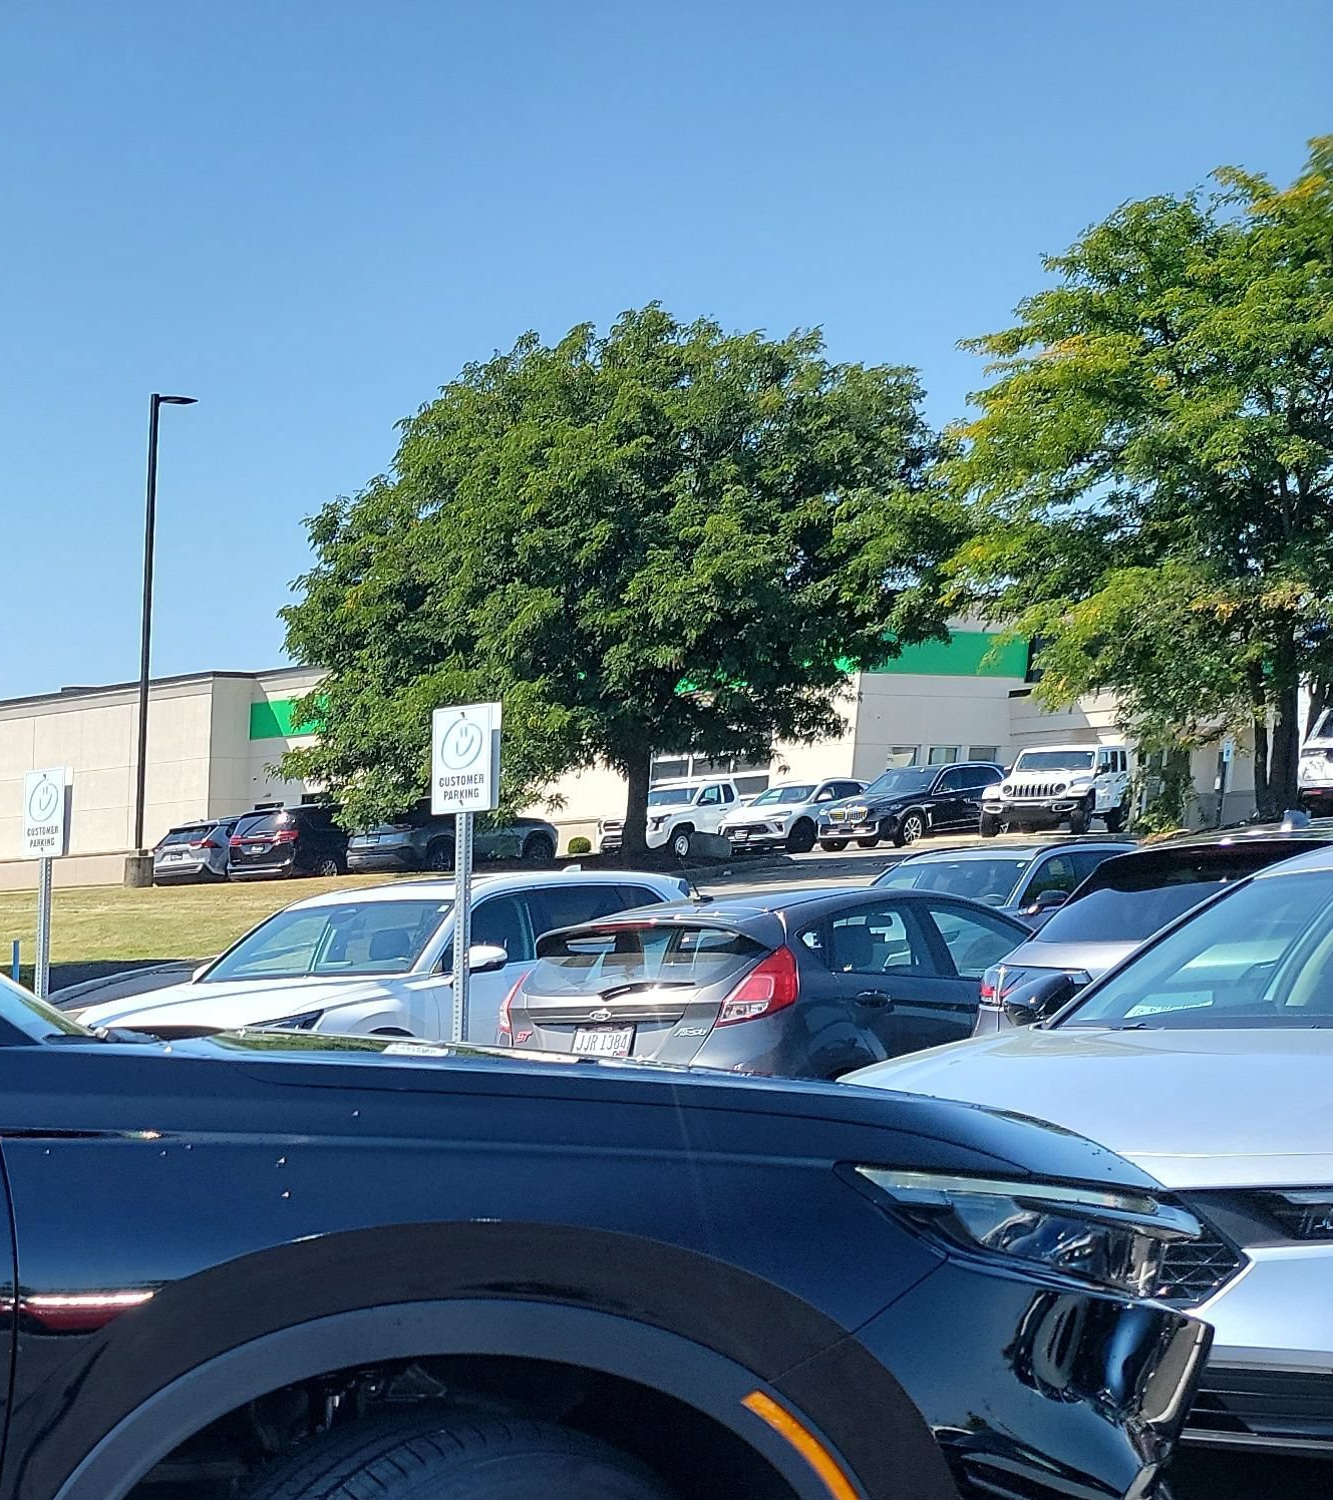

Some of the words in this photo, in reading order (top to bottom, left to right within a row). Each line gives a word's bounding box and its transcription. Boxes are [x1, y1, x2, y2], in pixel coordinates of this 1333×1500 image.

[439, 774, 485, 788] CUSTOMER
[443, 787, 480, 801] PARKING
[27, 825, 59, 837] CUSTOMER
[29, 837, 55, 848] PARKING
